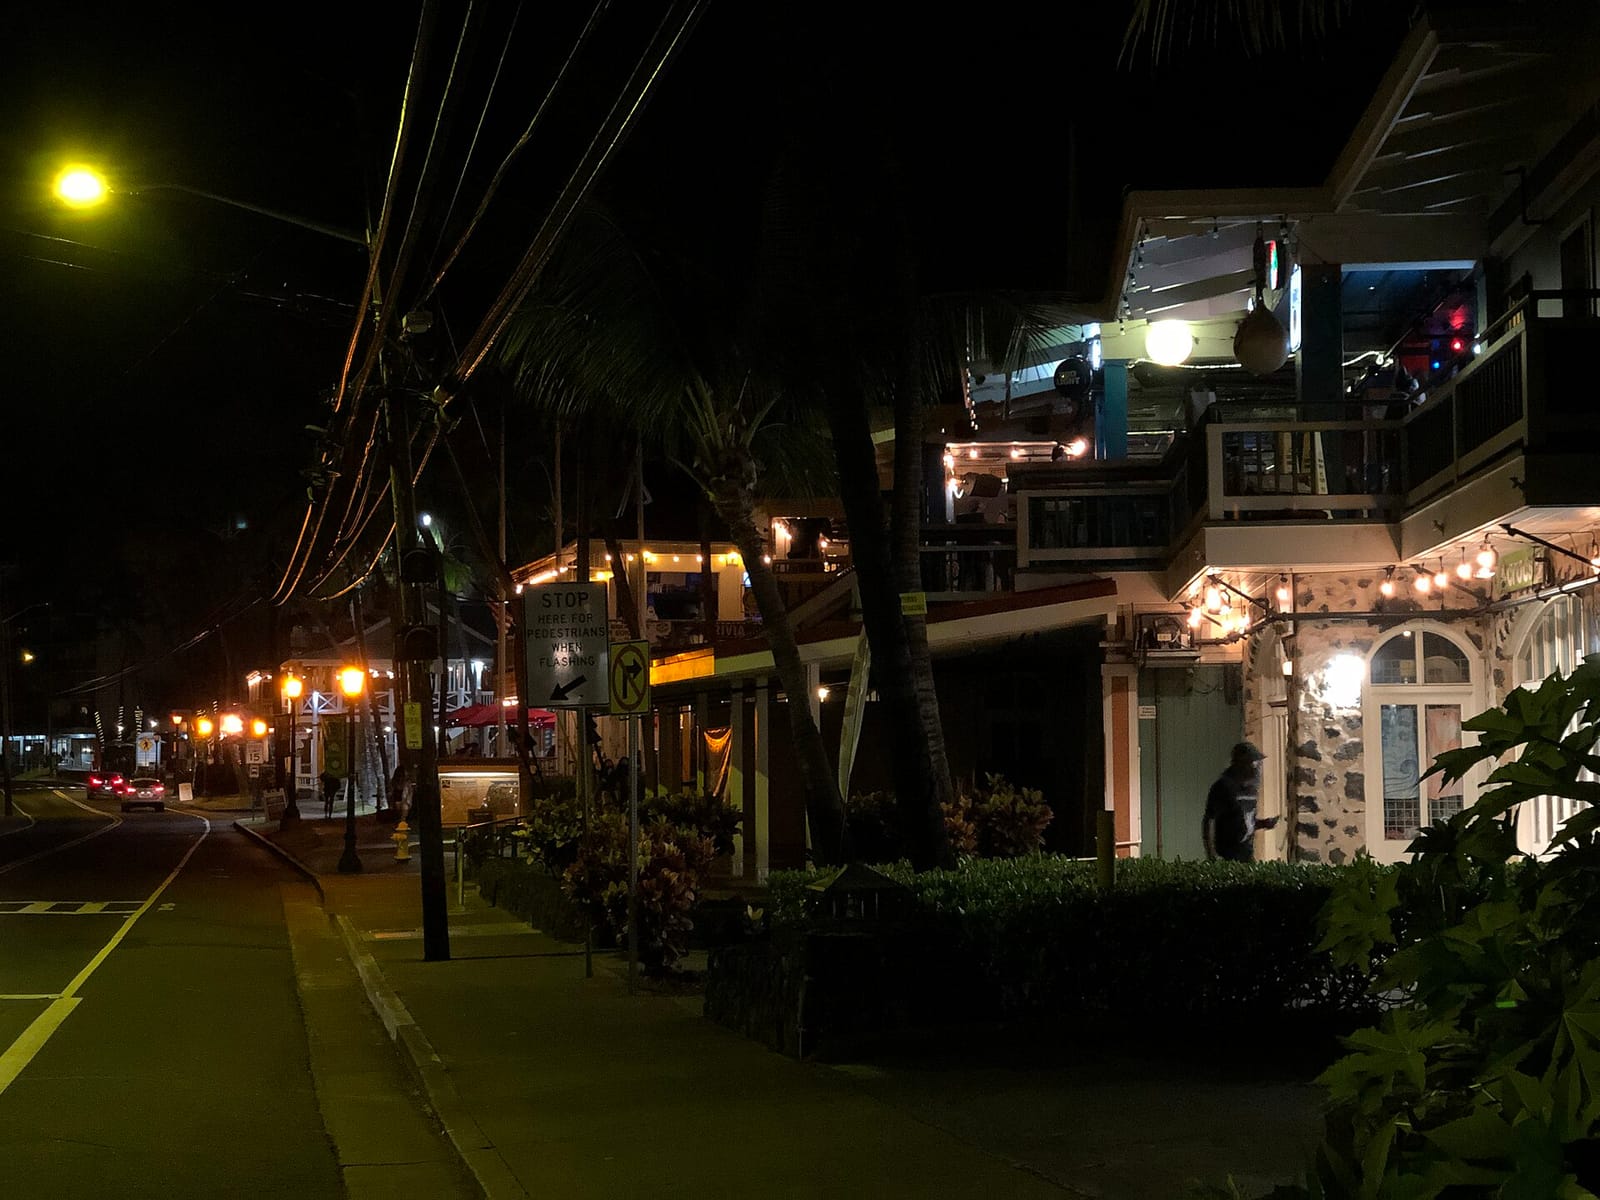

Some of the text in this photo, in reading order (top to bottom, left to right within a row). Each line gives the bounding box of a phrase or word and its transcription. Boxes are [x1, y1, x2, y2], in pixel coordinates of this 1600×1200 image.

[542, 592, 589, 608] STOP
[538, 613, 593, 624] HERE FOR
[527, 627, 605, 638] PEDESTRIANS
[714, 623, 745, 636] RIVIA
[552, 642, 582, 653] WHEN
[540, 656, 595, 667] FLASHING
[250, 753, 260, 761] 15
